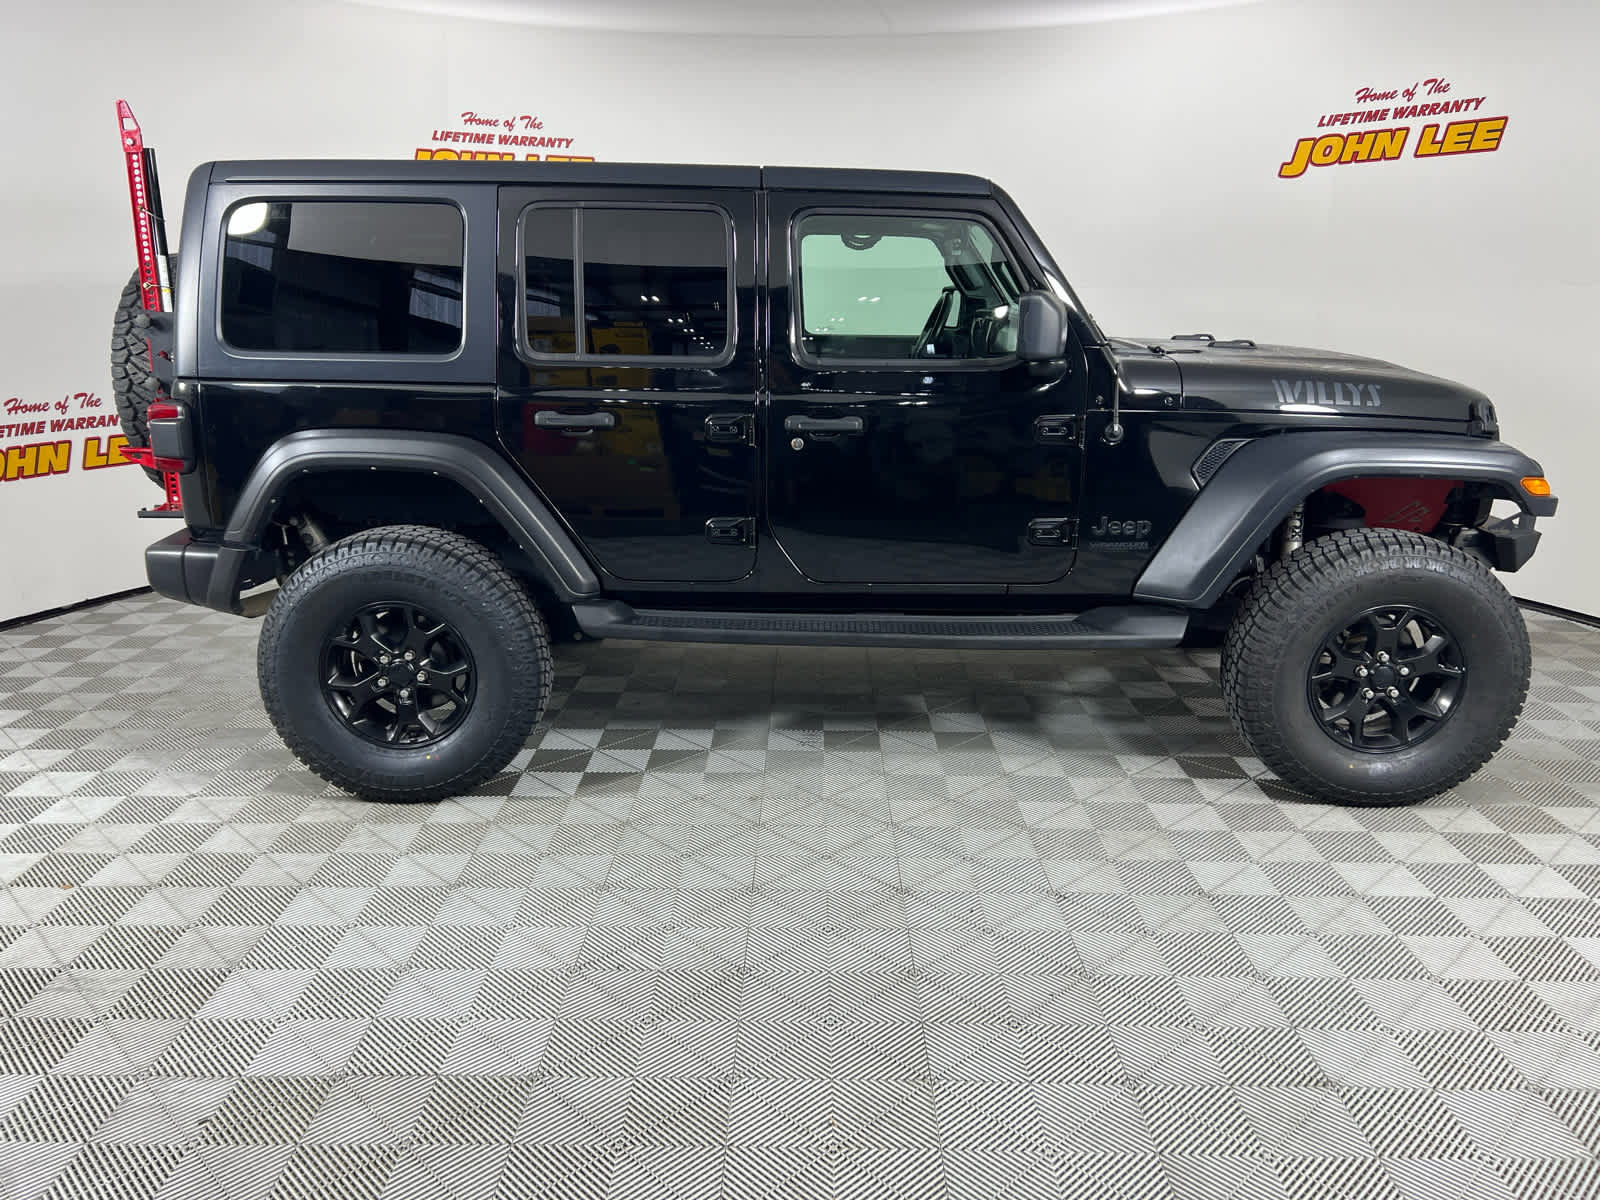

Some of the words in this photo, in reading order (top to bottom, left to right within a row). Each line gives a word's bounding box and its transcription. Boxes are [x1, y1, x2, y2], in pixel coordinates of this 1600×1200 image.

[1354, 87, 1398, 104] Home
[1402, 82, 1418, 102] of
[1423, 78, 1450, 96] The
[461, 111, 499, 127] Home
[503, 116, 516, 131] of
[520, 115, 544, 130] The
[1317, 108, 1390, 127] LIFETIME
[1392, 96, 1486, 119] WARRANTY
[432, 130, 495, 144] LIFETIME
[498, 134, 574, 149] WARRANTY
[1278, 126, 1410, 178] JOHN
[1414, 116, 1509, 158] LEE
[3, 397, 50, 415] Home
[54, 395, 69, 414] of
[74, 392, 102, 409] The
[1272, 379, 1381, 407] WILLYS
[1091, 515, 1152, 539] Jeep
